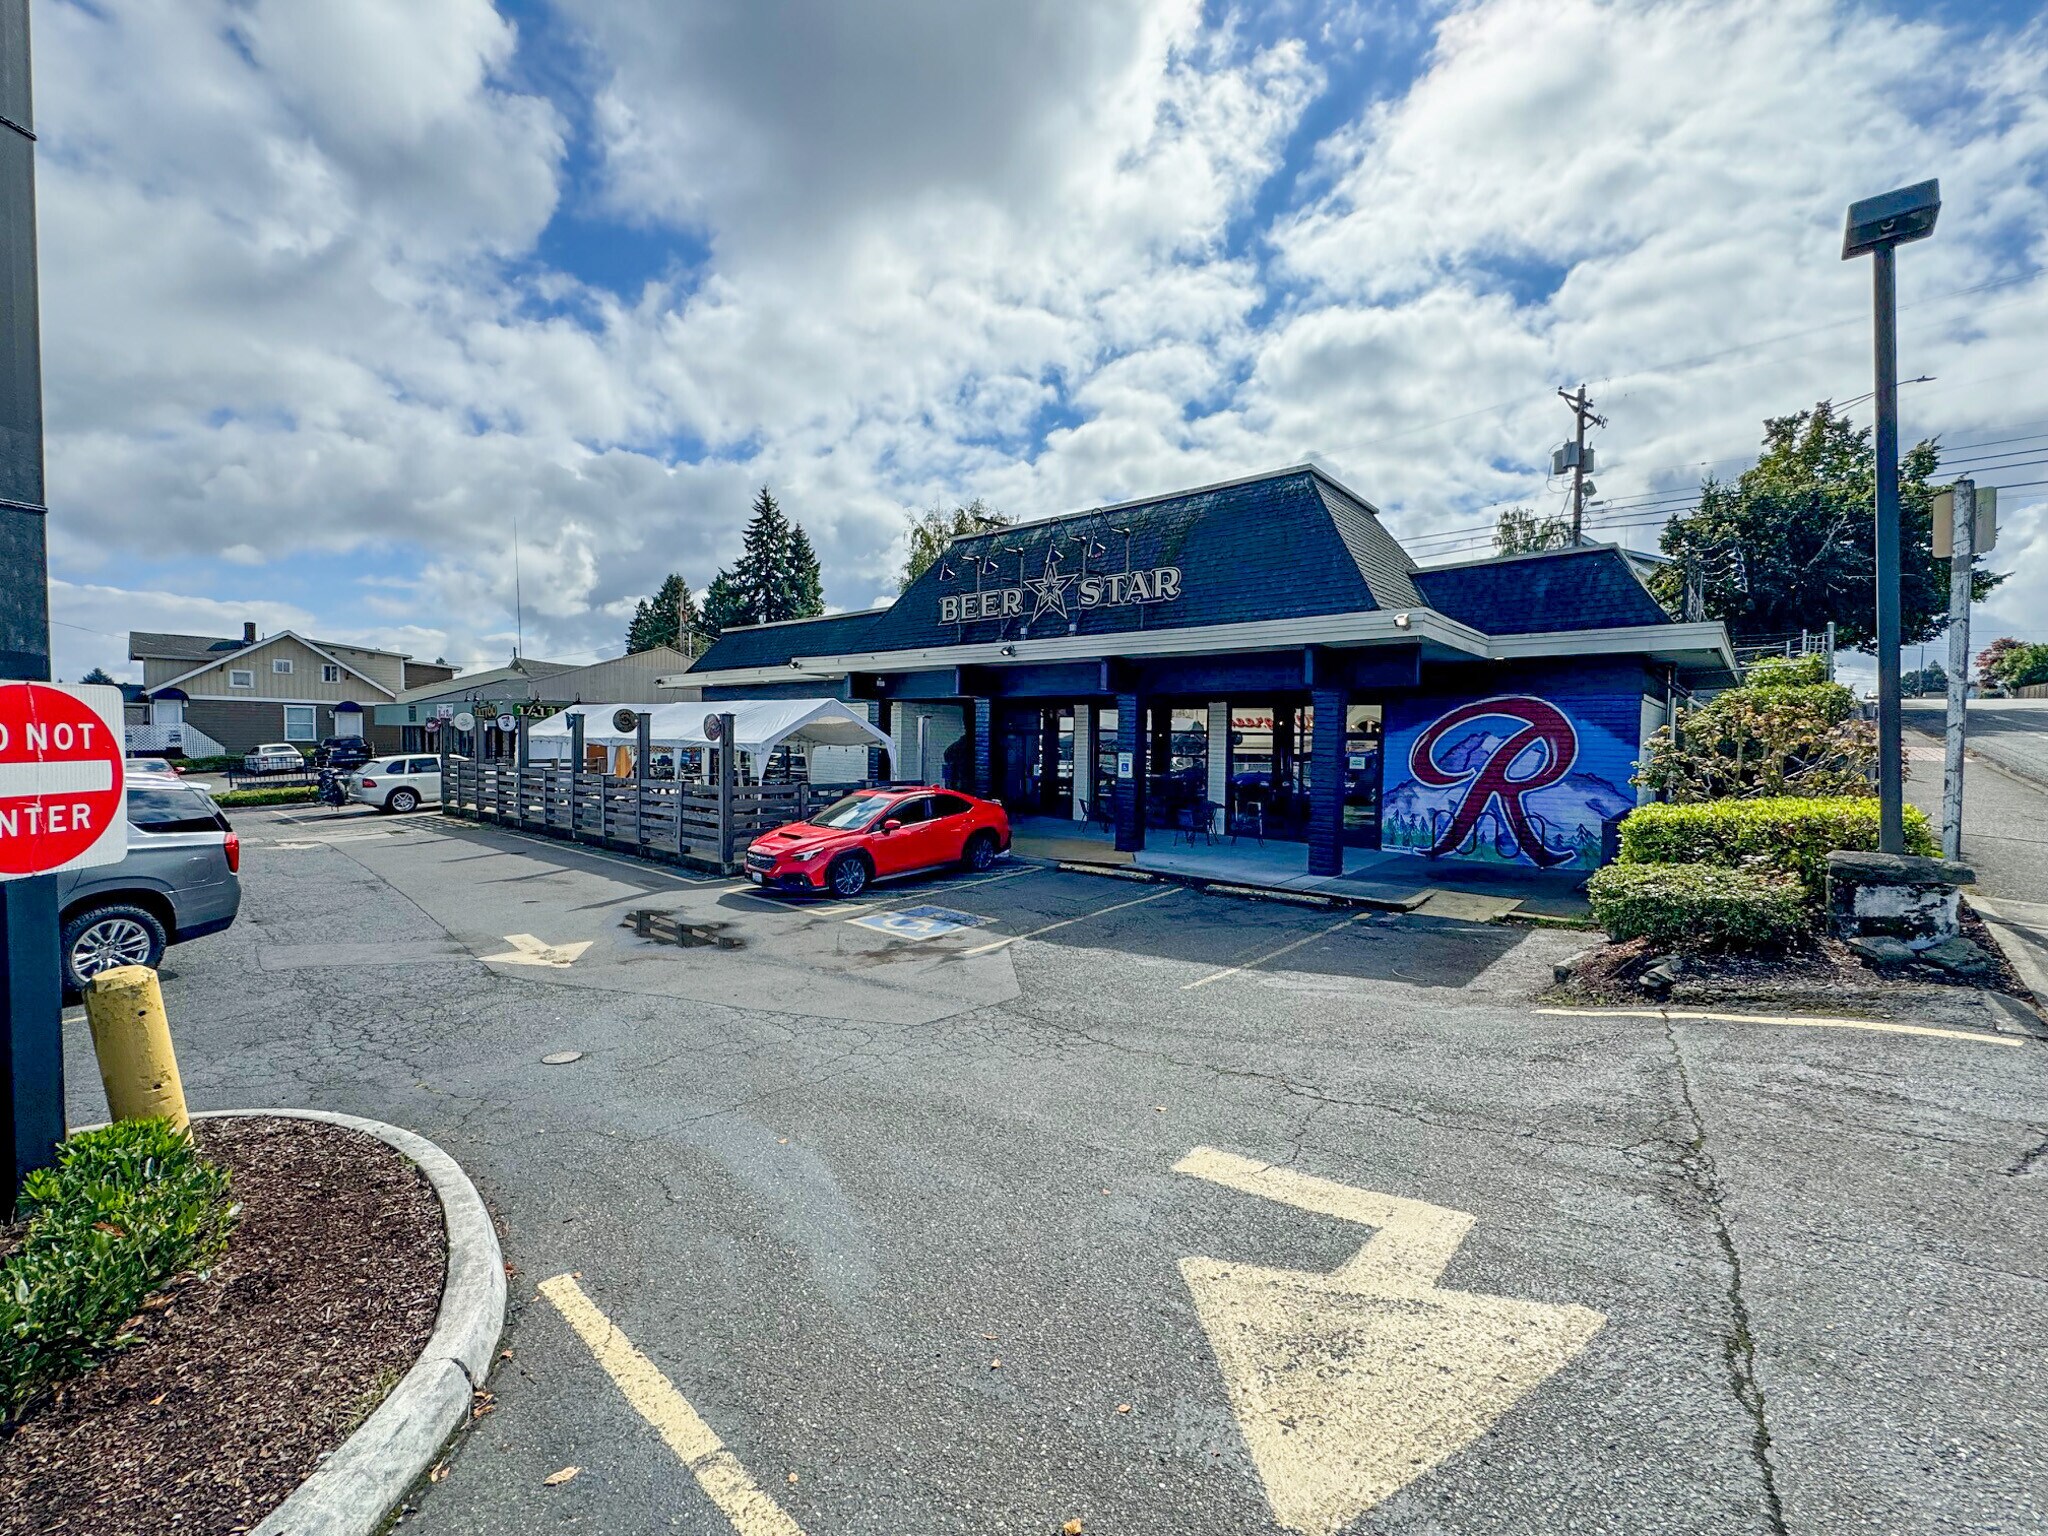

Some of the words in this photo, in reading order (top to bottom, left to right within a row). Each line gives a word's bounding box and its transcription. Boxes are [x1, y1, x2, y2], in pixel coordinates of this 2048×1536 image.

[938, 587, 1023, 626] BEER
[1077, 566, 1182, 610] STAR
[26, 723, 95, 750] NOT
[1409, 694, 1578, 868] R
[0, 803, 91, 839] NTER
